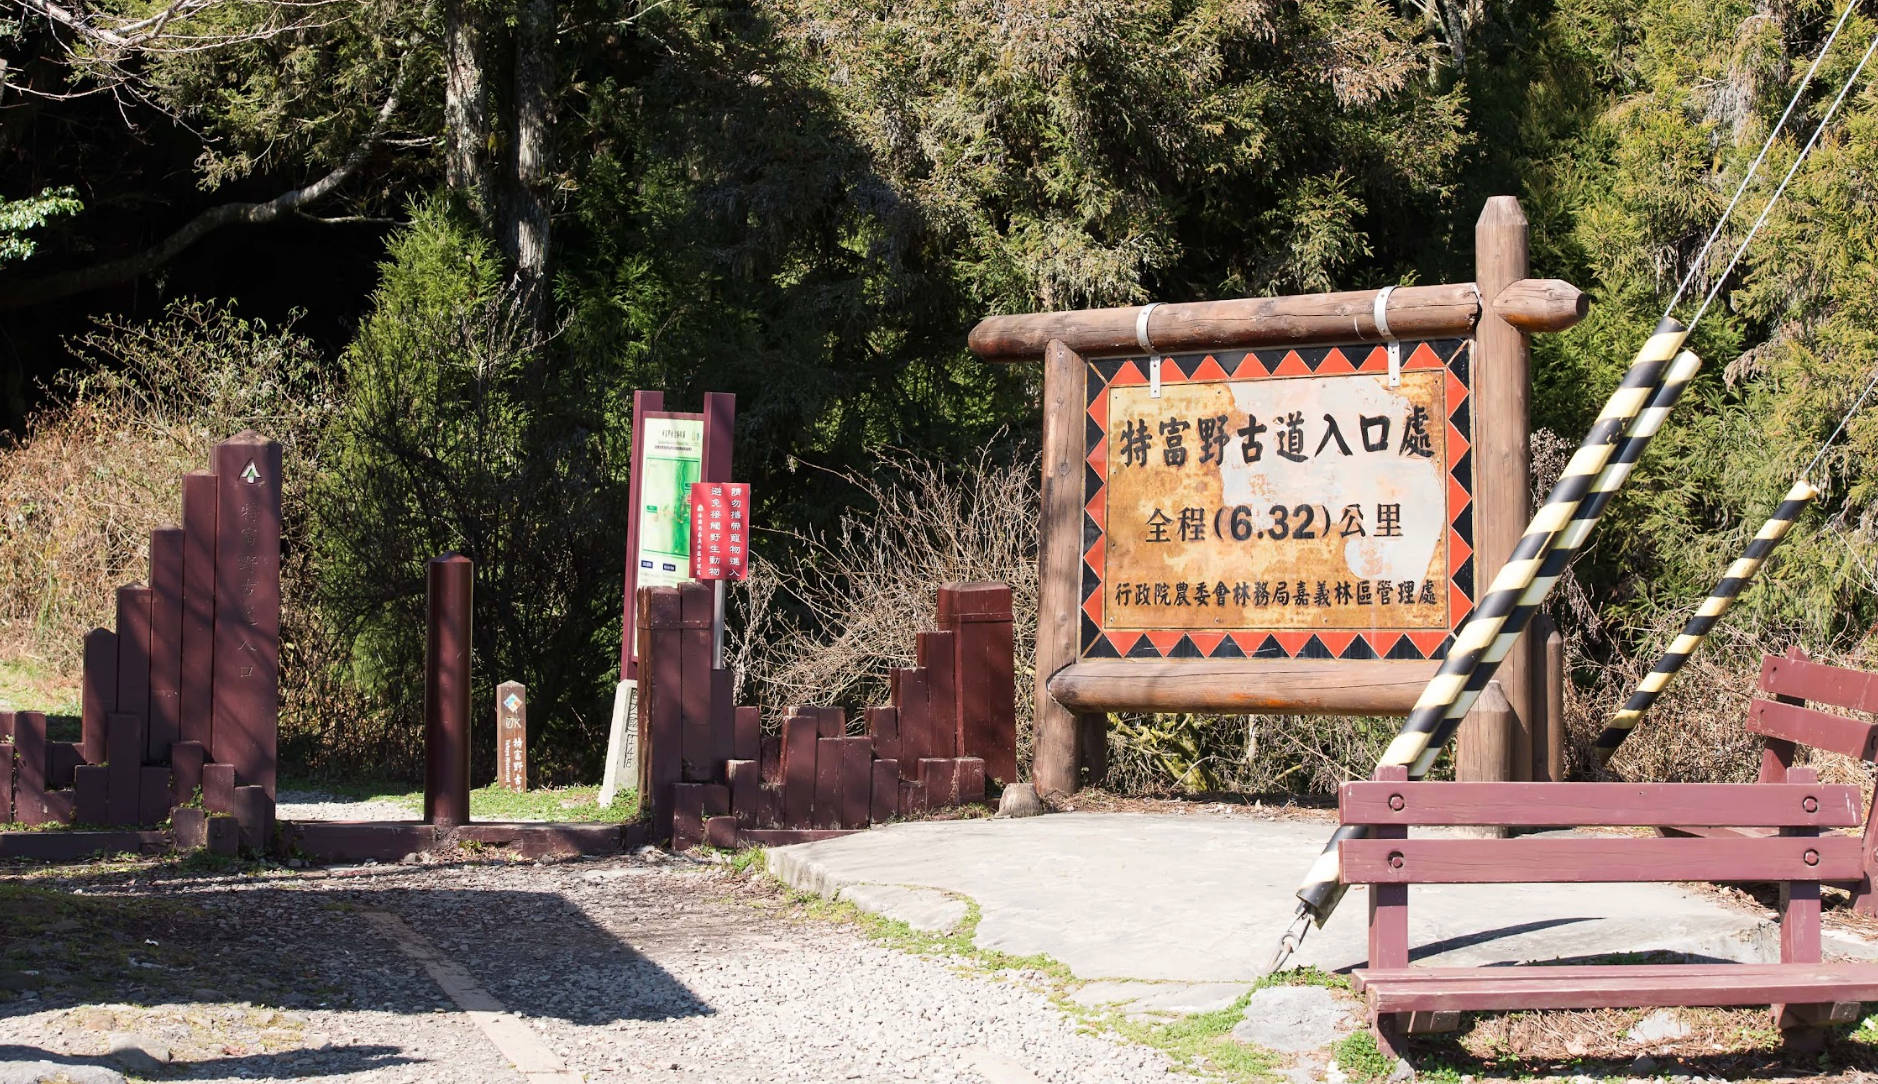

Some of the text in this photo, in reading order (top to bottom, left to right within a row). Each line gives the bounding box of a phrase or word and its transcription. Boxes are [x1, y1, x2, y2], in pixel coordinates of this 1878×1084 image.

[1119, 404, 1436, 468] 特富野古道入口處
[708, 486, 722, 576] 避免接觸野生動物
[1145, 502, 1404, 543] 全程(6.32)公里
[1115, 580, 1438, 608] 行政院農委會林務局嘉義林區管理處
